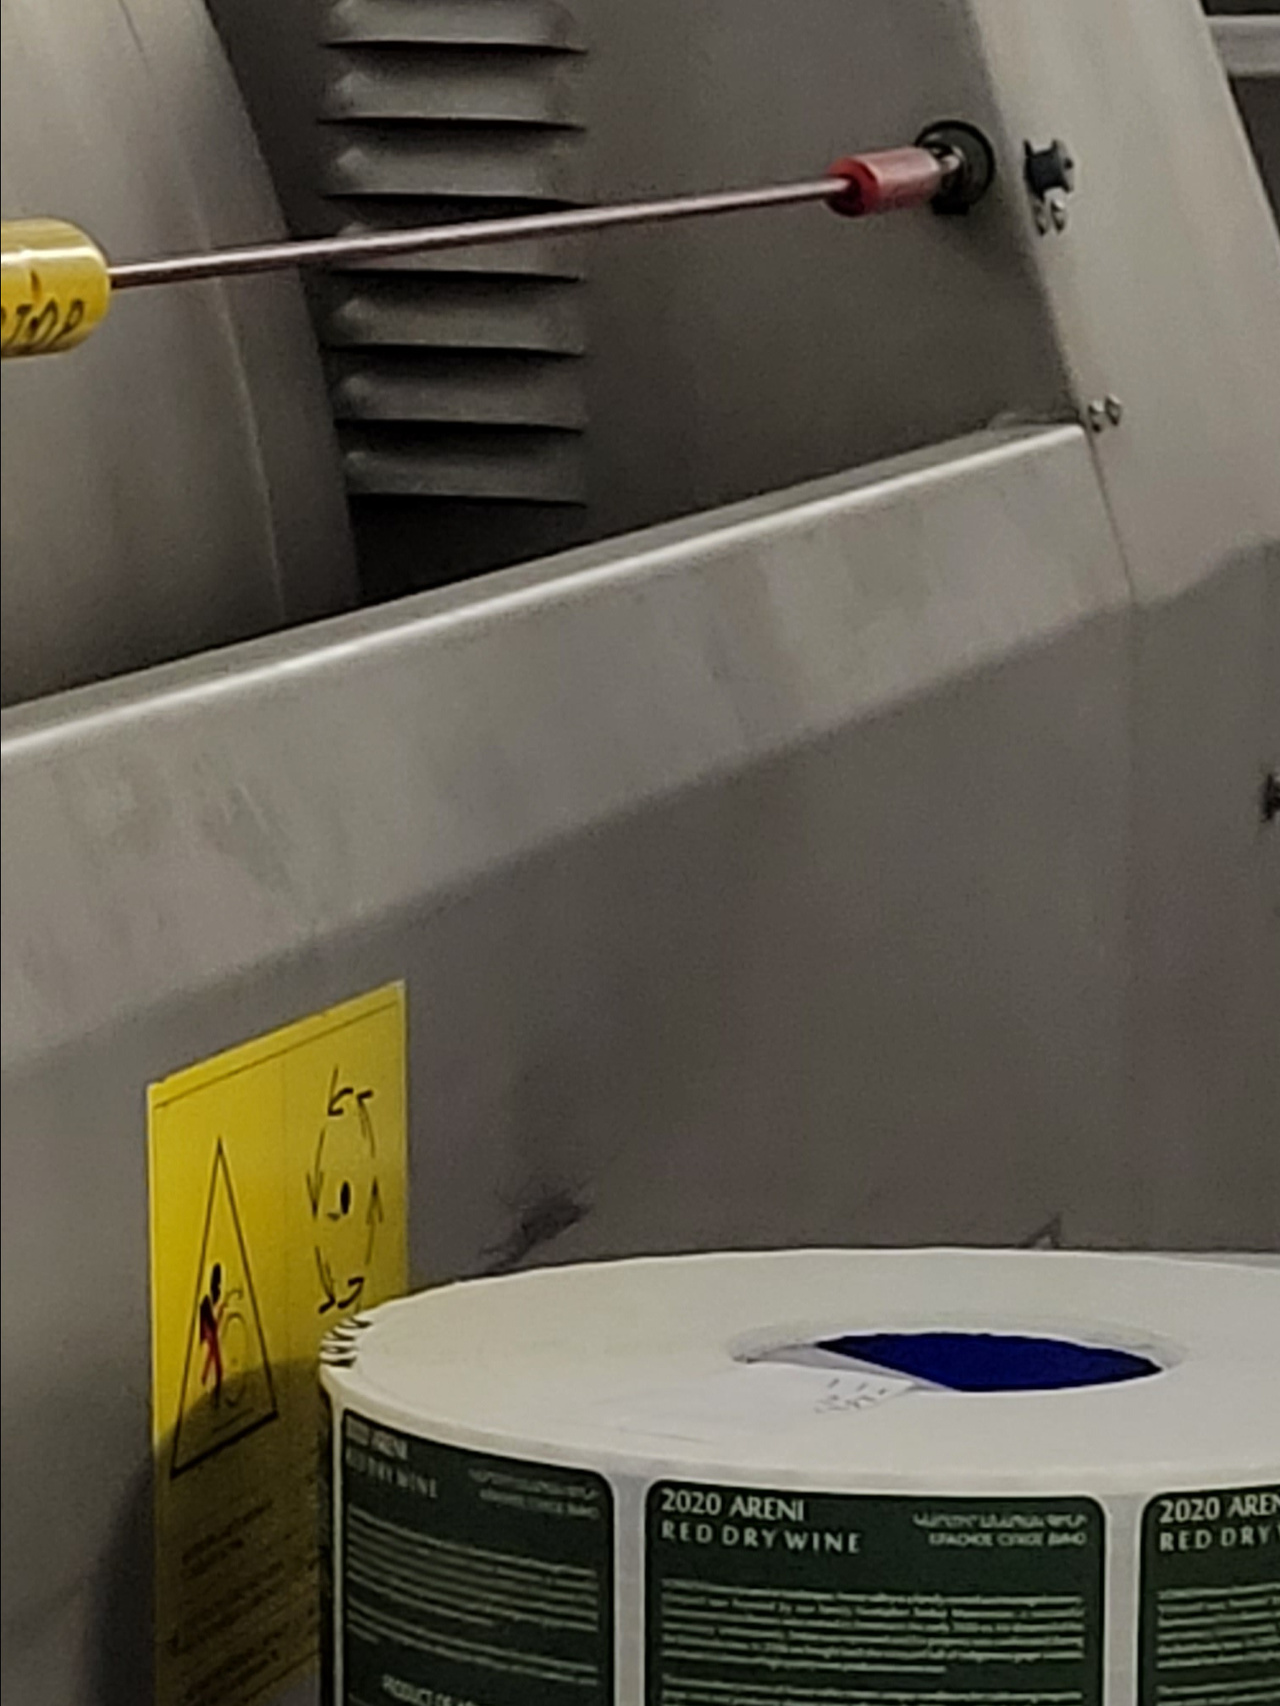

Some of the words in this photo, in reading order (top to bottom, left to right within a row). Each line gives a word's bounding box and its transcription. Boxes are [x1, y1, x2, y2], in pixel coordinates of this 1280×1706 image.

[661, 1487, 722, 1516] 2020
[728, 1495, 805, 1522] ARENI
[1159, 1496, 1221, 1524] 2020
[661, 1519, 714, 1545] RED
[722, 1524, 778, 1549] DRY
[783, 1529, 862, 1555] WINE
[1159, 1529, 1213, 1552] RED
[1221, 1524, 1272, 1548] DRY
